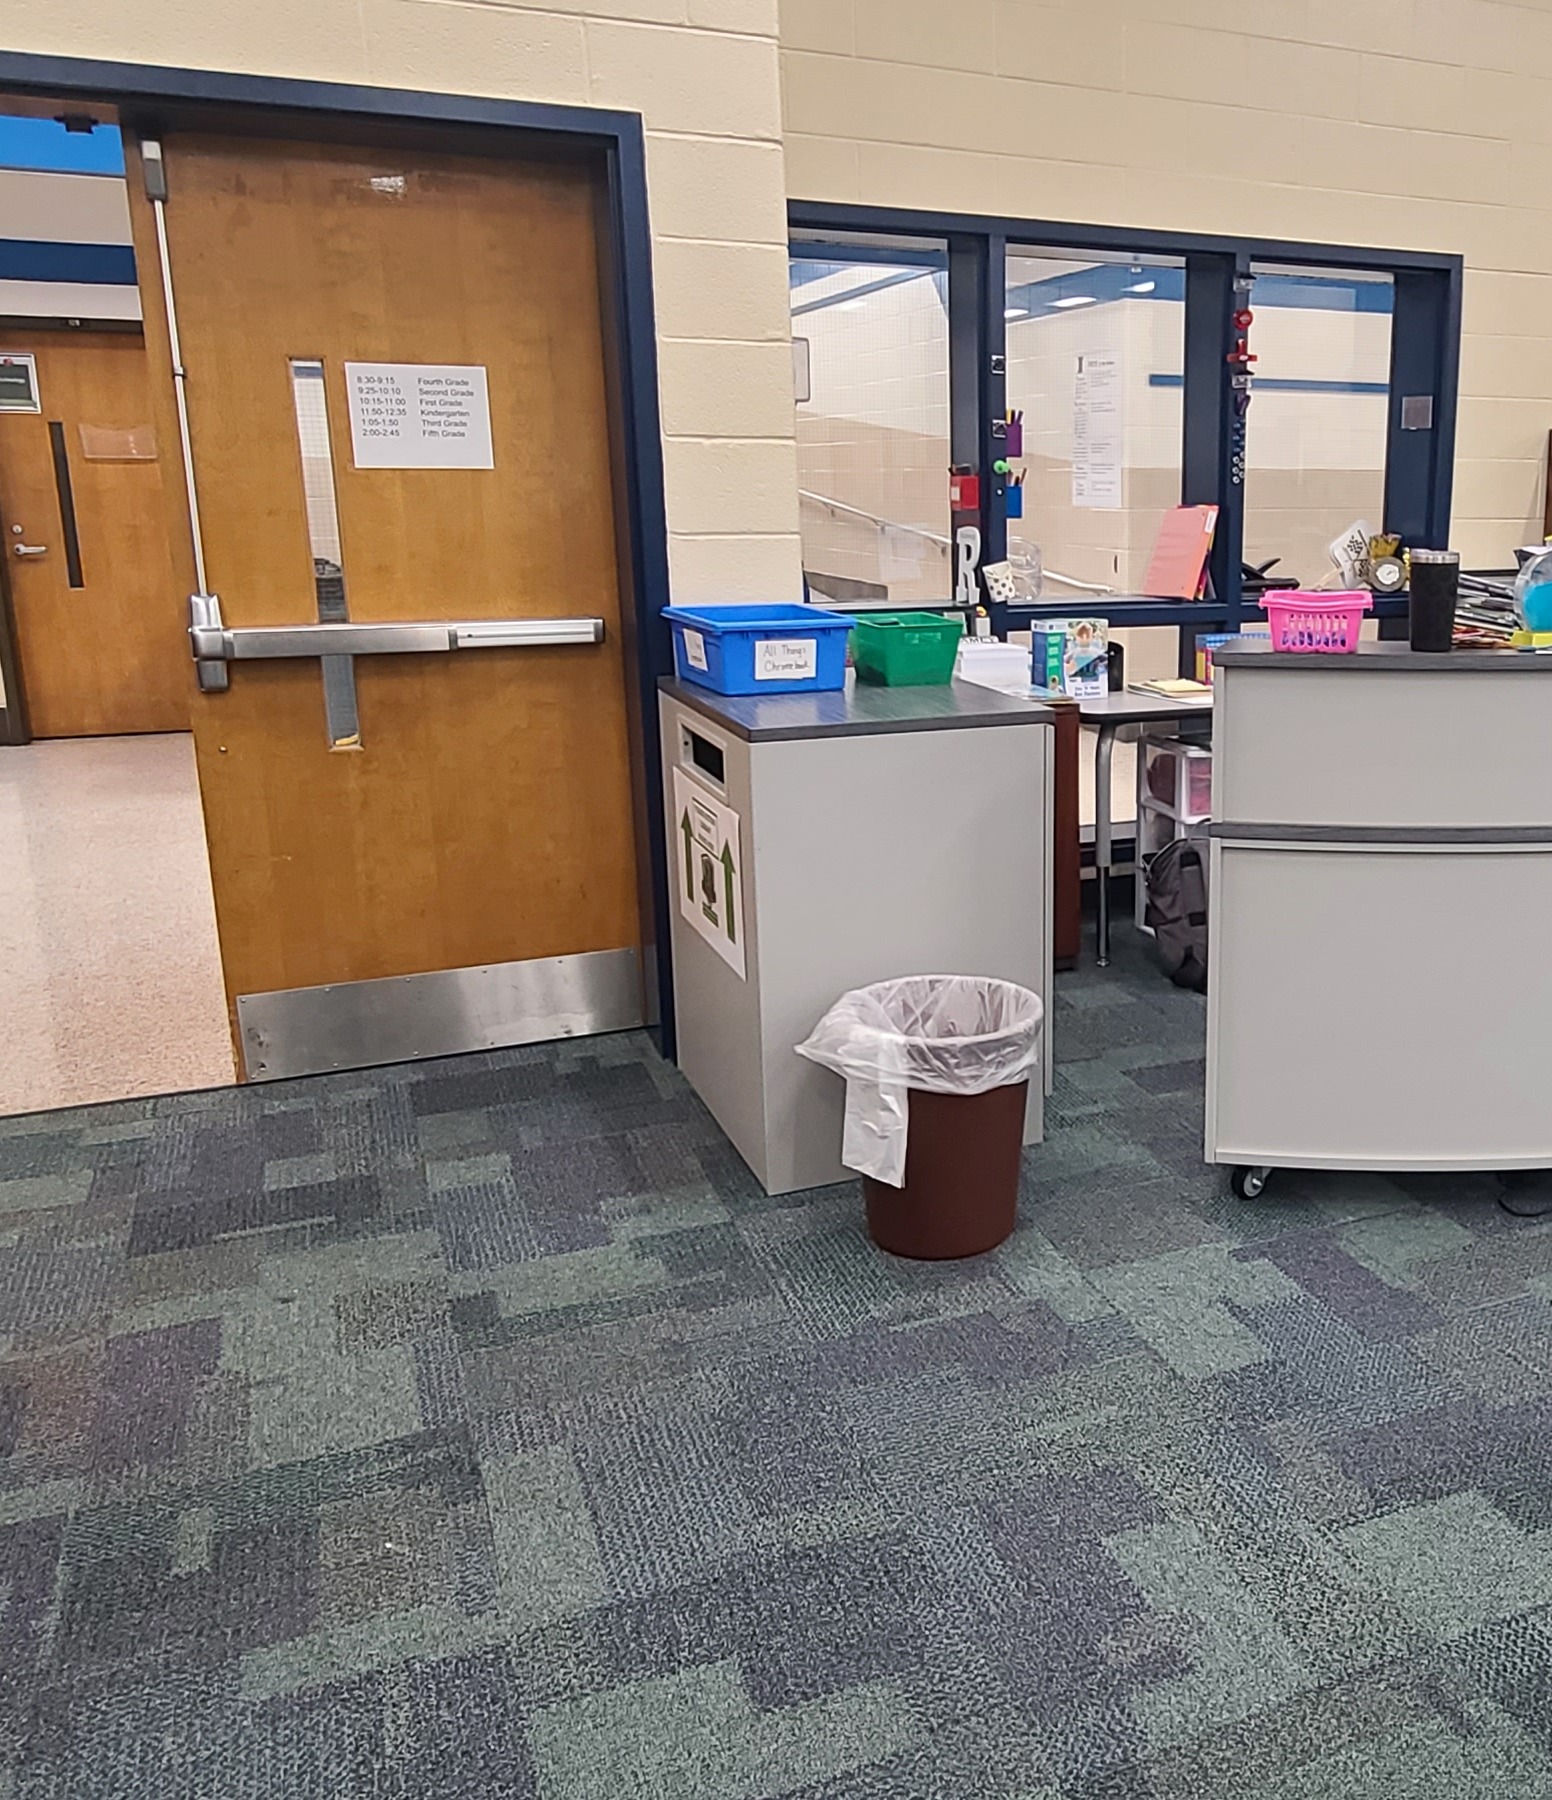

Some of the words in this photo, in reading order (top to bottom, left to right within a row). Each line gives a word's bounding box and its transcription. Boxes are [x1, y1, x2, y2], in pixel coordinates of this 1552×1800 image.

[418, 378, 443, 386] Fourth
[445, 378, 469, 386] Grade
[419, 388, 448, 396] Second
[450, 389, 474, 397] Grade
[439, 399, 463, 407] Grade
[420, 409, 470, 418] Kindergarten
[421, 419, 442, 427] Third
[442, 430, 465, 438] Grade
[956, 526, 981, 605] R
[763, 644, 777, 657] All
